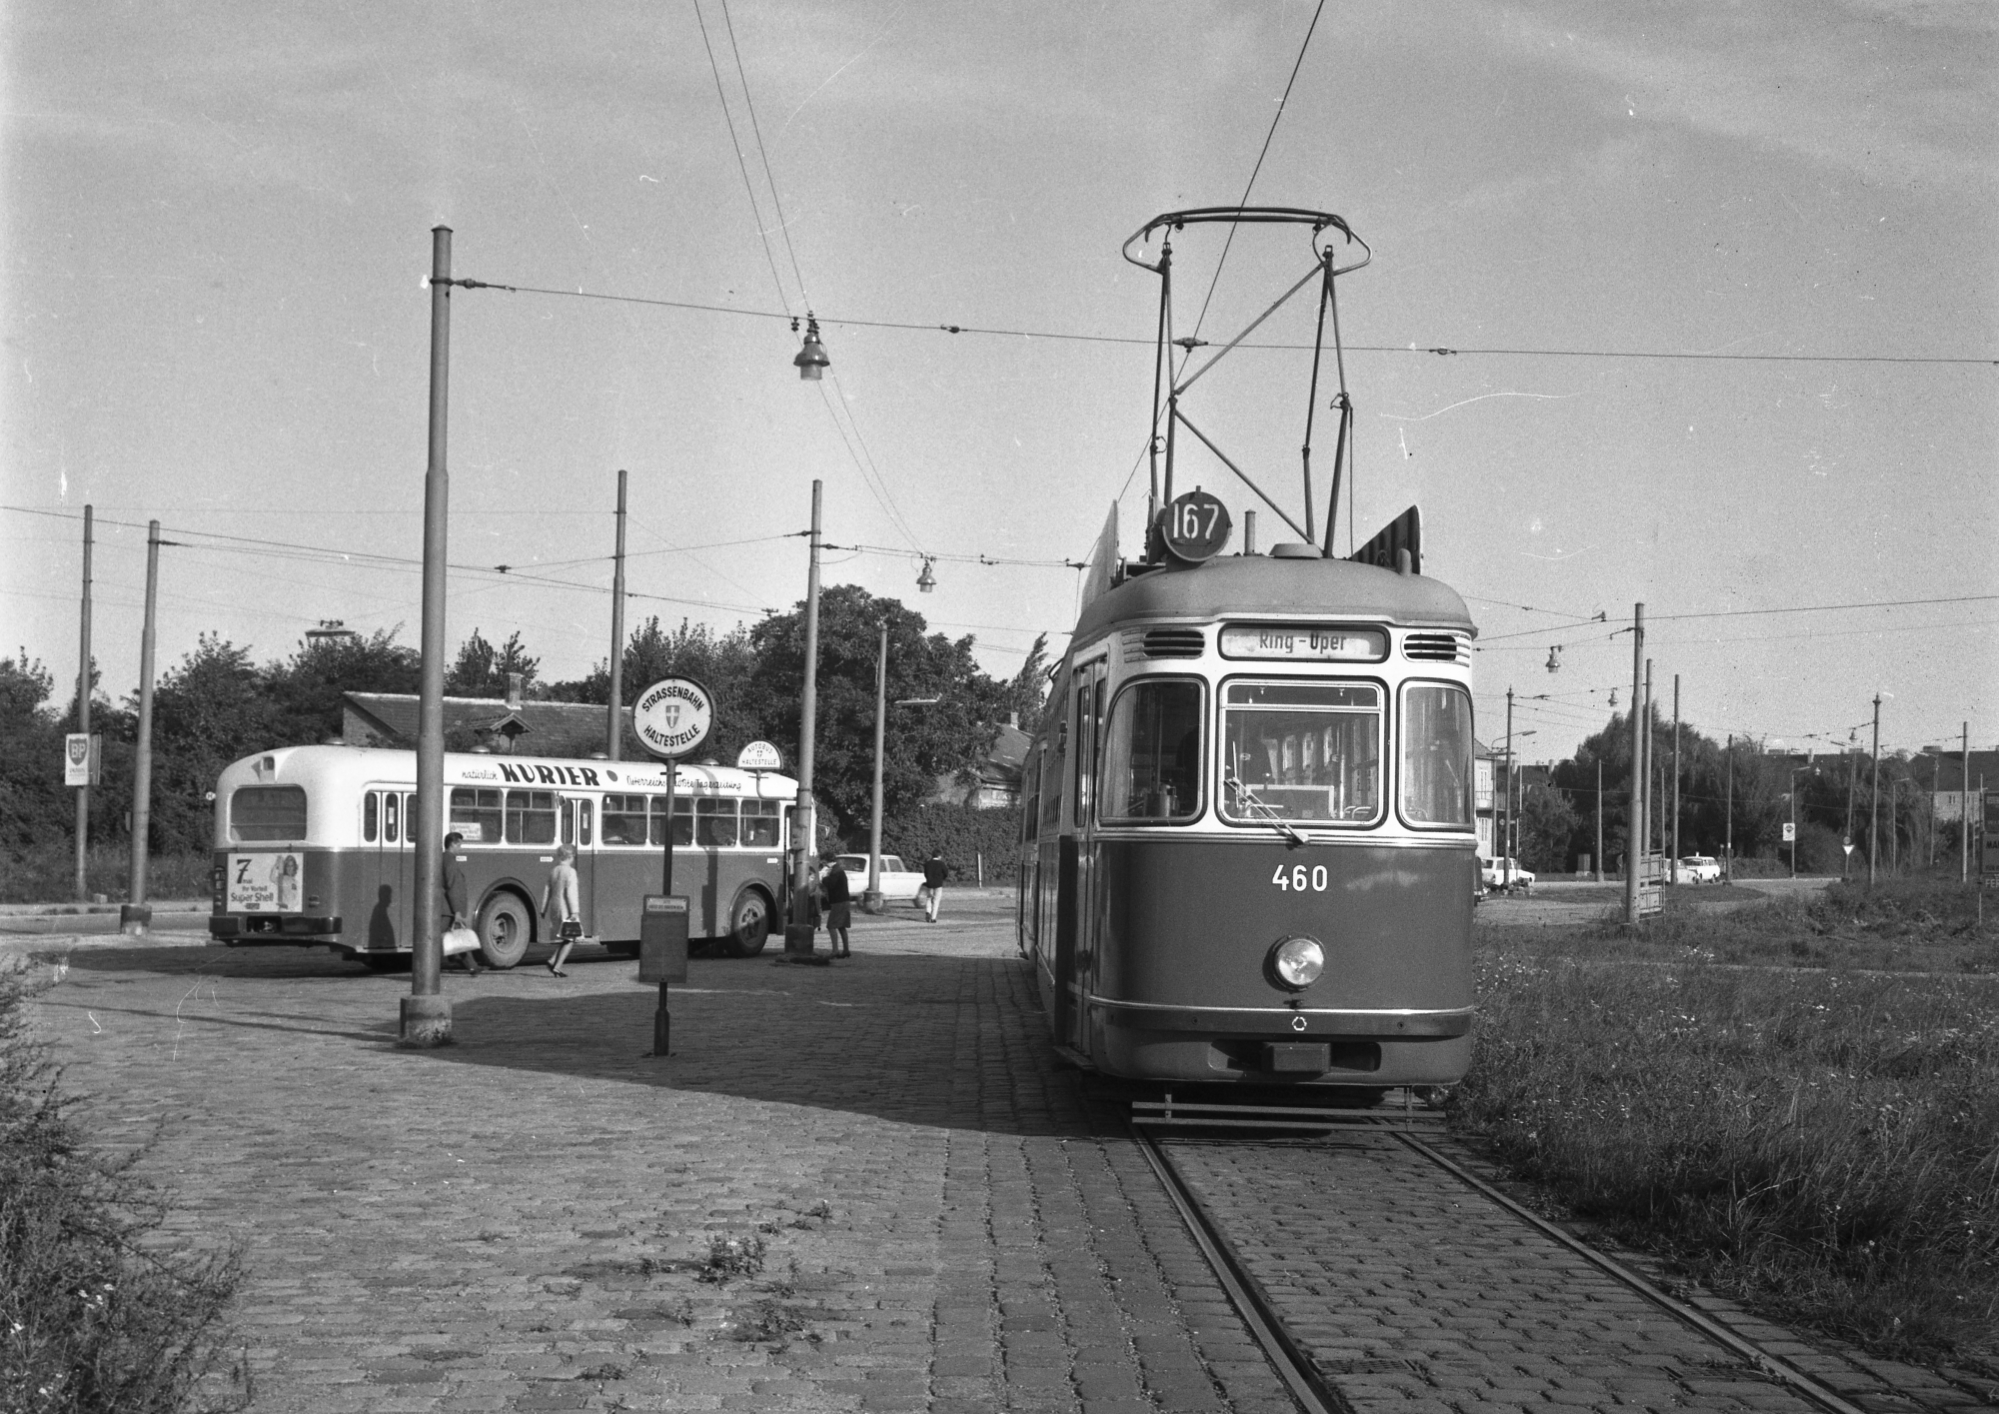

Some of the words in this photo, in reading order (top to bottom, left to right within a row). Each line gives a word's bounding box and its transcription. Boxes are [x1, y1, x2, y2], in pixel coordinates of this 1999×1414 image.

[1173, 503, 1219, 540] 167
[1259, 630, 1294, 653] Ring
[1311, 629, 1346, 654] Oper
[642, 686, 704, 712] STRASSENBAHN
[644, 724, 700, 747] HALTESTELLE
[71, 743, 86, 758] BP
[747, 743, 773, 754] AUTOBUS
[498, 762, 600, 787] KURIER
[742, 758, 777, 766] HALTESTELLE
[237, 859, 252, 884] 7
[1272, 864, 1327, 892] 460
[231, 892, 253, 903] Super
[255, 892, 274, 902] Shell
